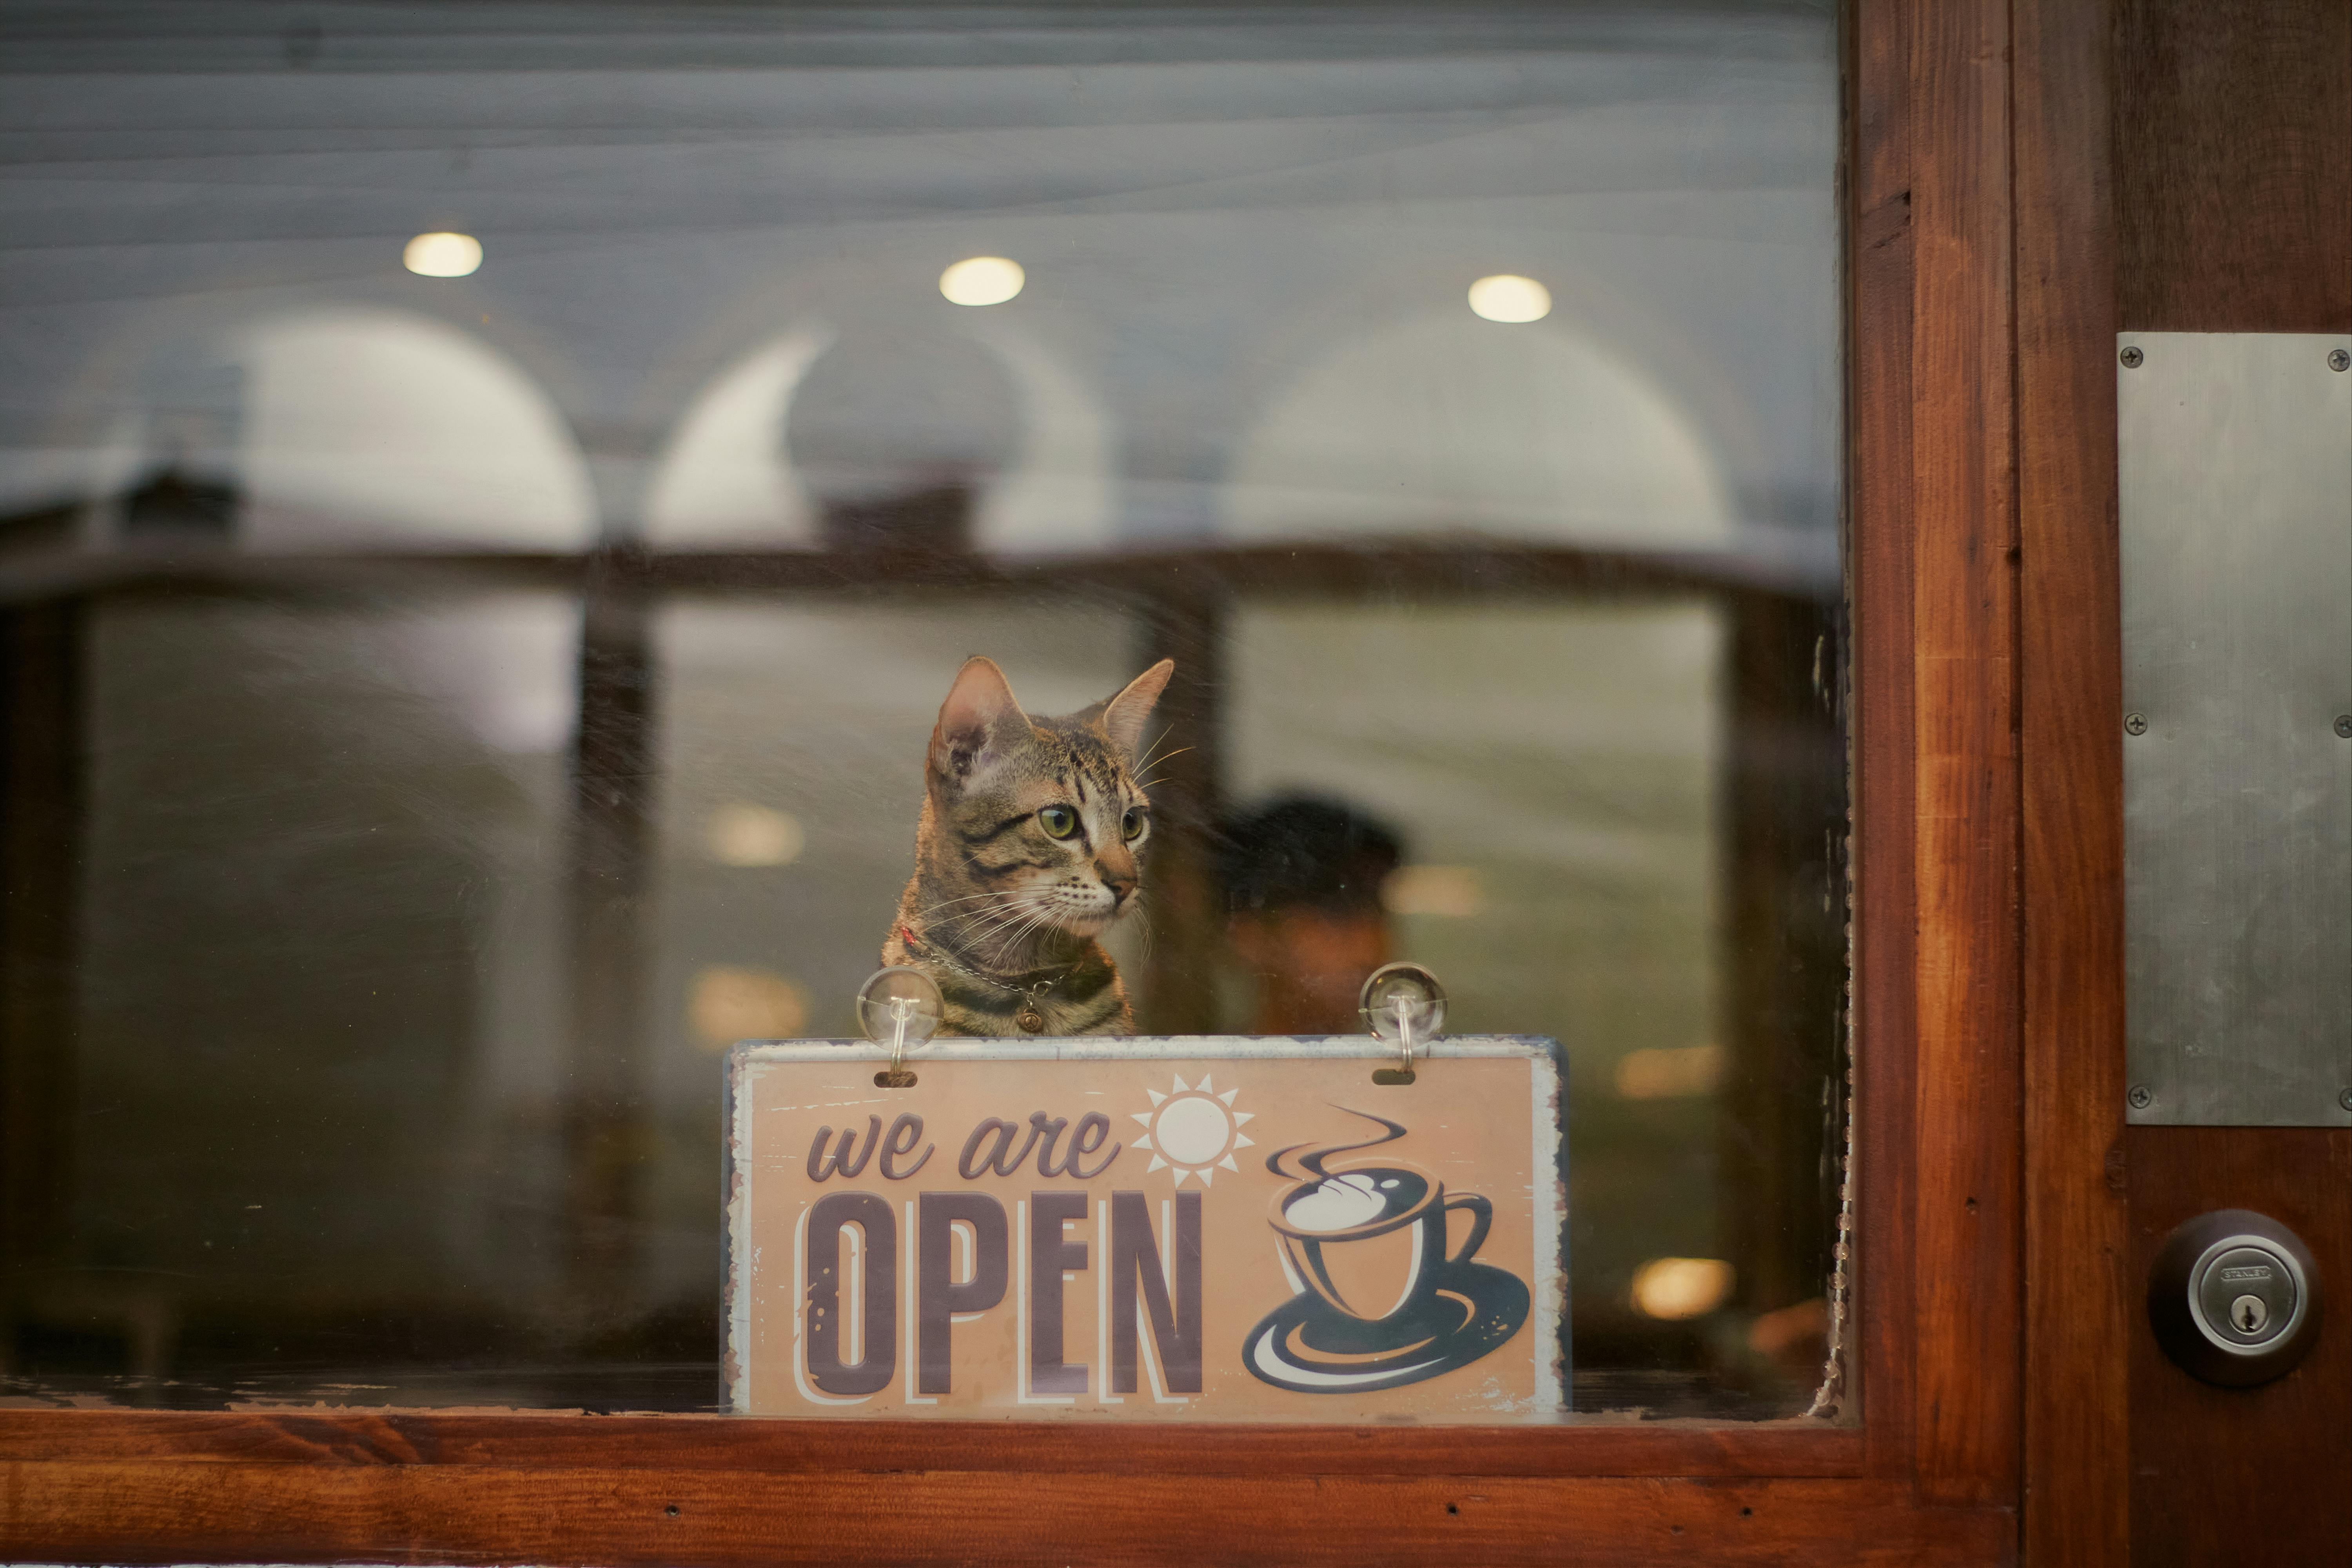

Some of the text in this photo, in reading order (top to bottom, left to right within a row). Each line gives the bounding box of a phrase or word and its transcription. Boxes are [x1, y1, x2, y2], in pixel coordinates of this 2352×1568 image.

[806, 1111, 1122, 1183] we are
[806, 1190, 1202, 1395] OPEN
